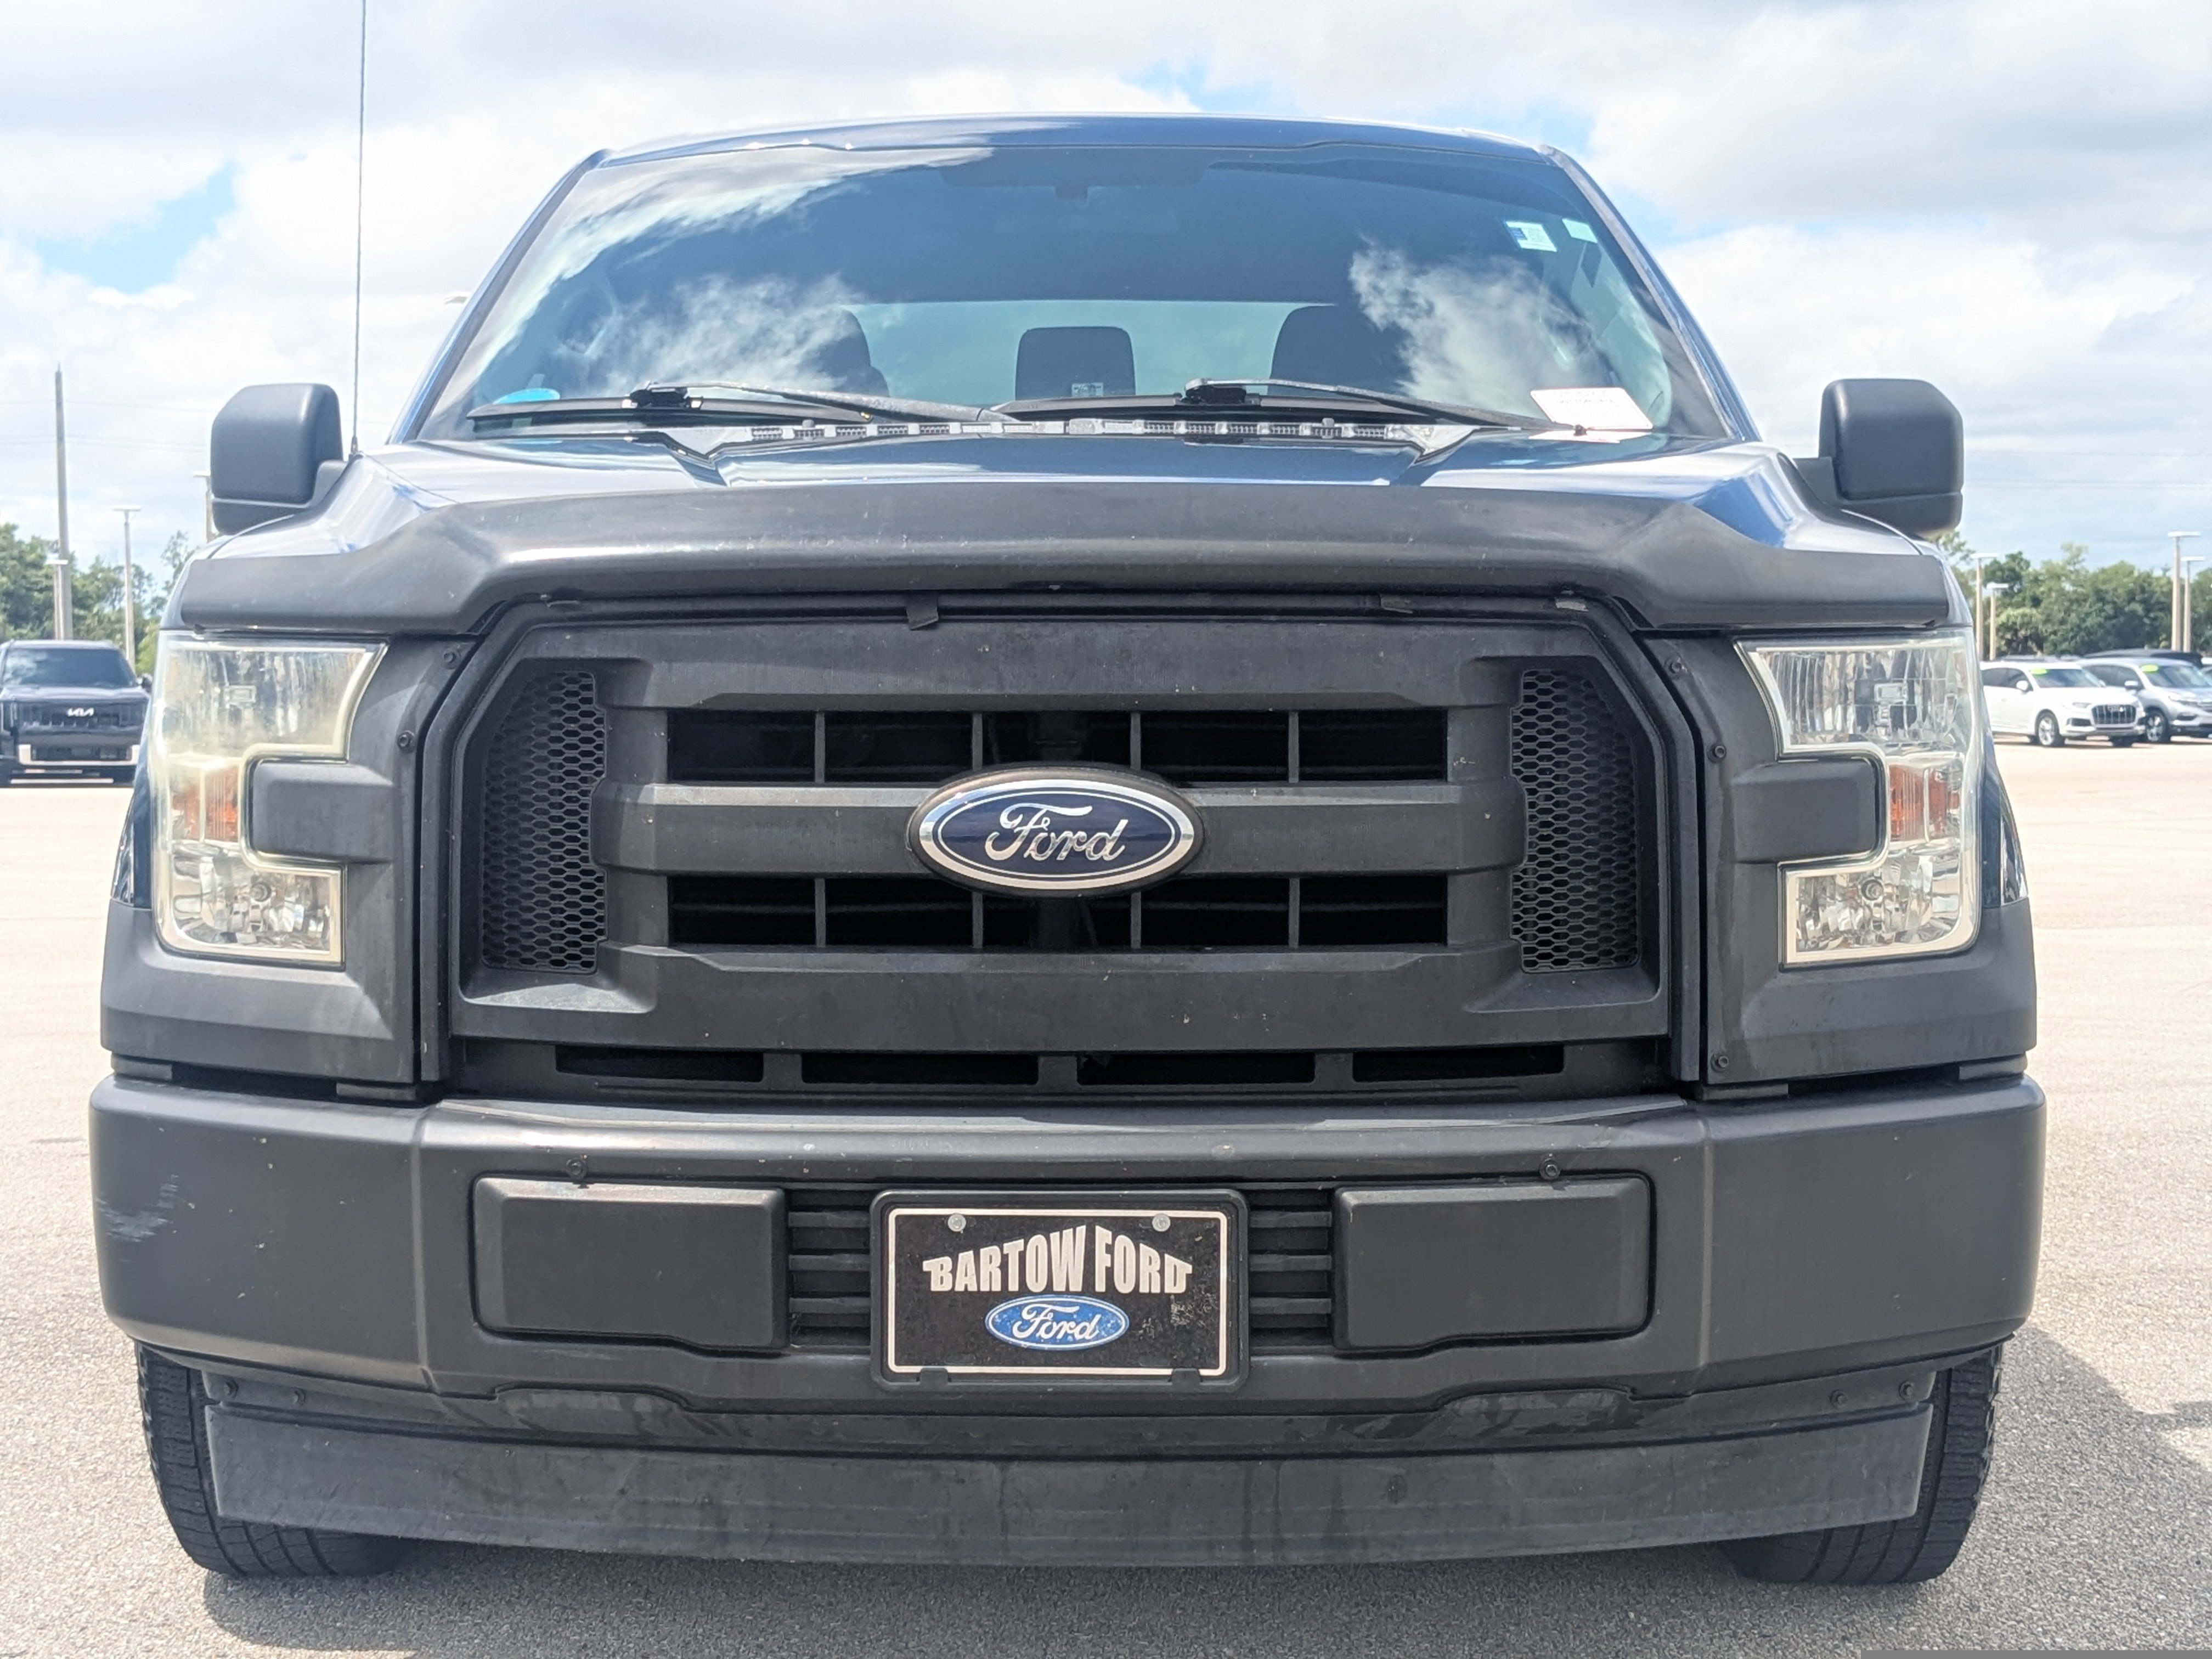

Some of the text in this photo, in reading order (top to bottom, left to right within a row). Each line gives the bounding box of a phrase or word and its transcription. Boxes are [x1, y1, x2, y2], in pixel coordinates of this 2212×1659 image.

[985, 803, 1128, 860] Ford
[923, 1225, 1192, 1293] BARTOW FORD
[1013, 1304, 1101, 1339] Ford
